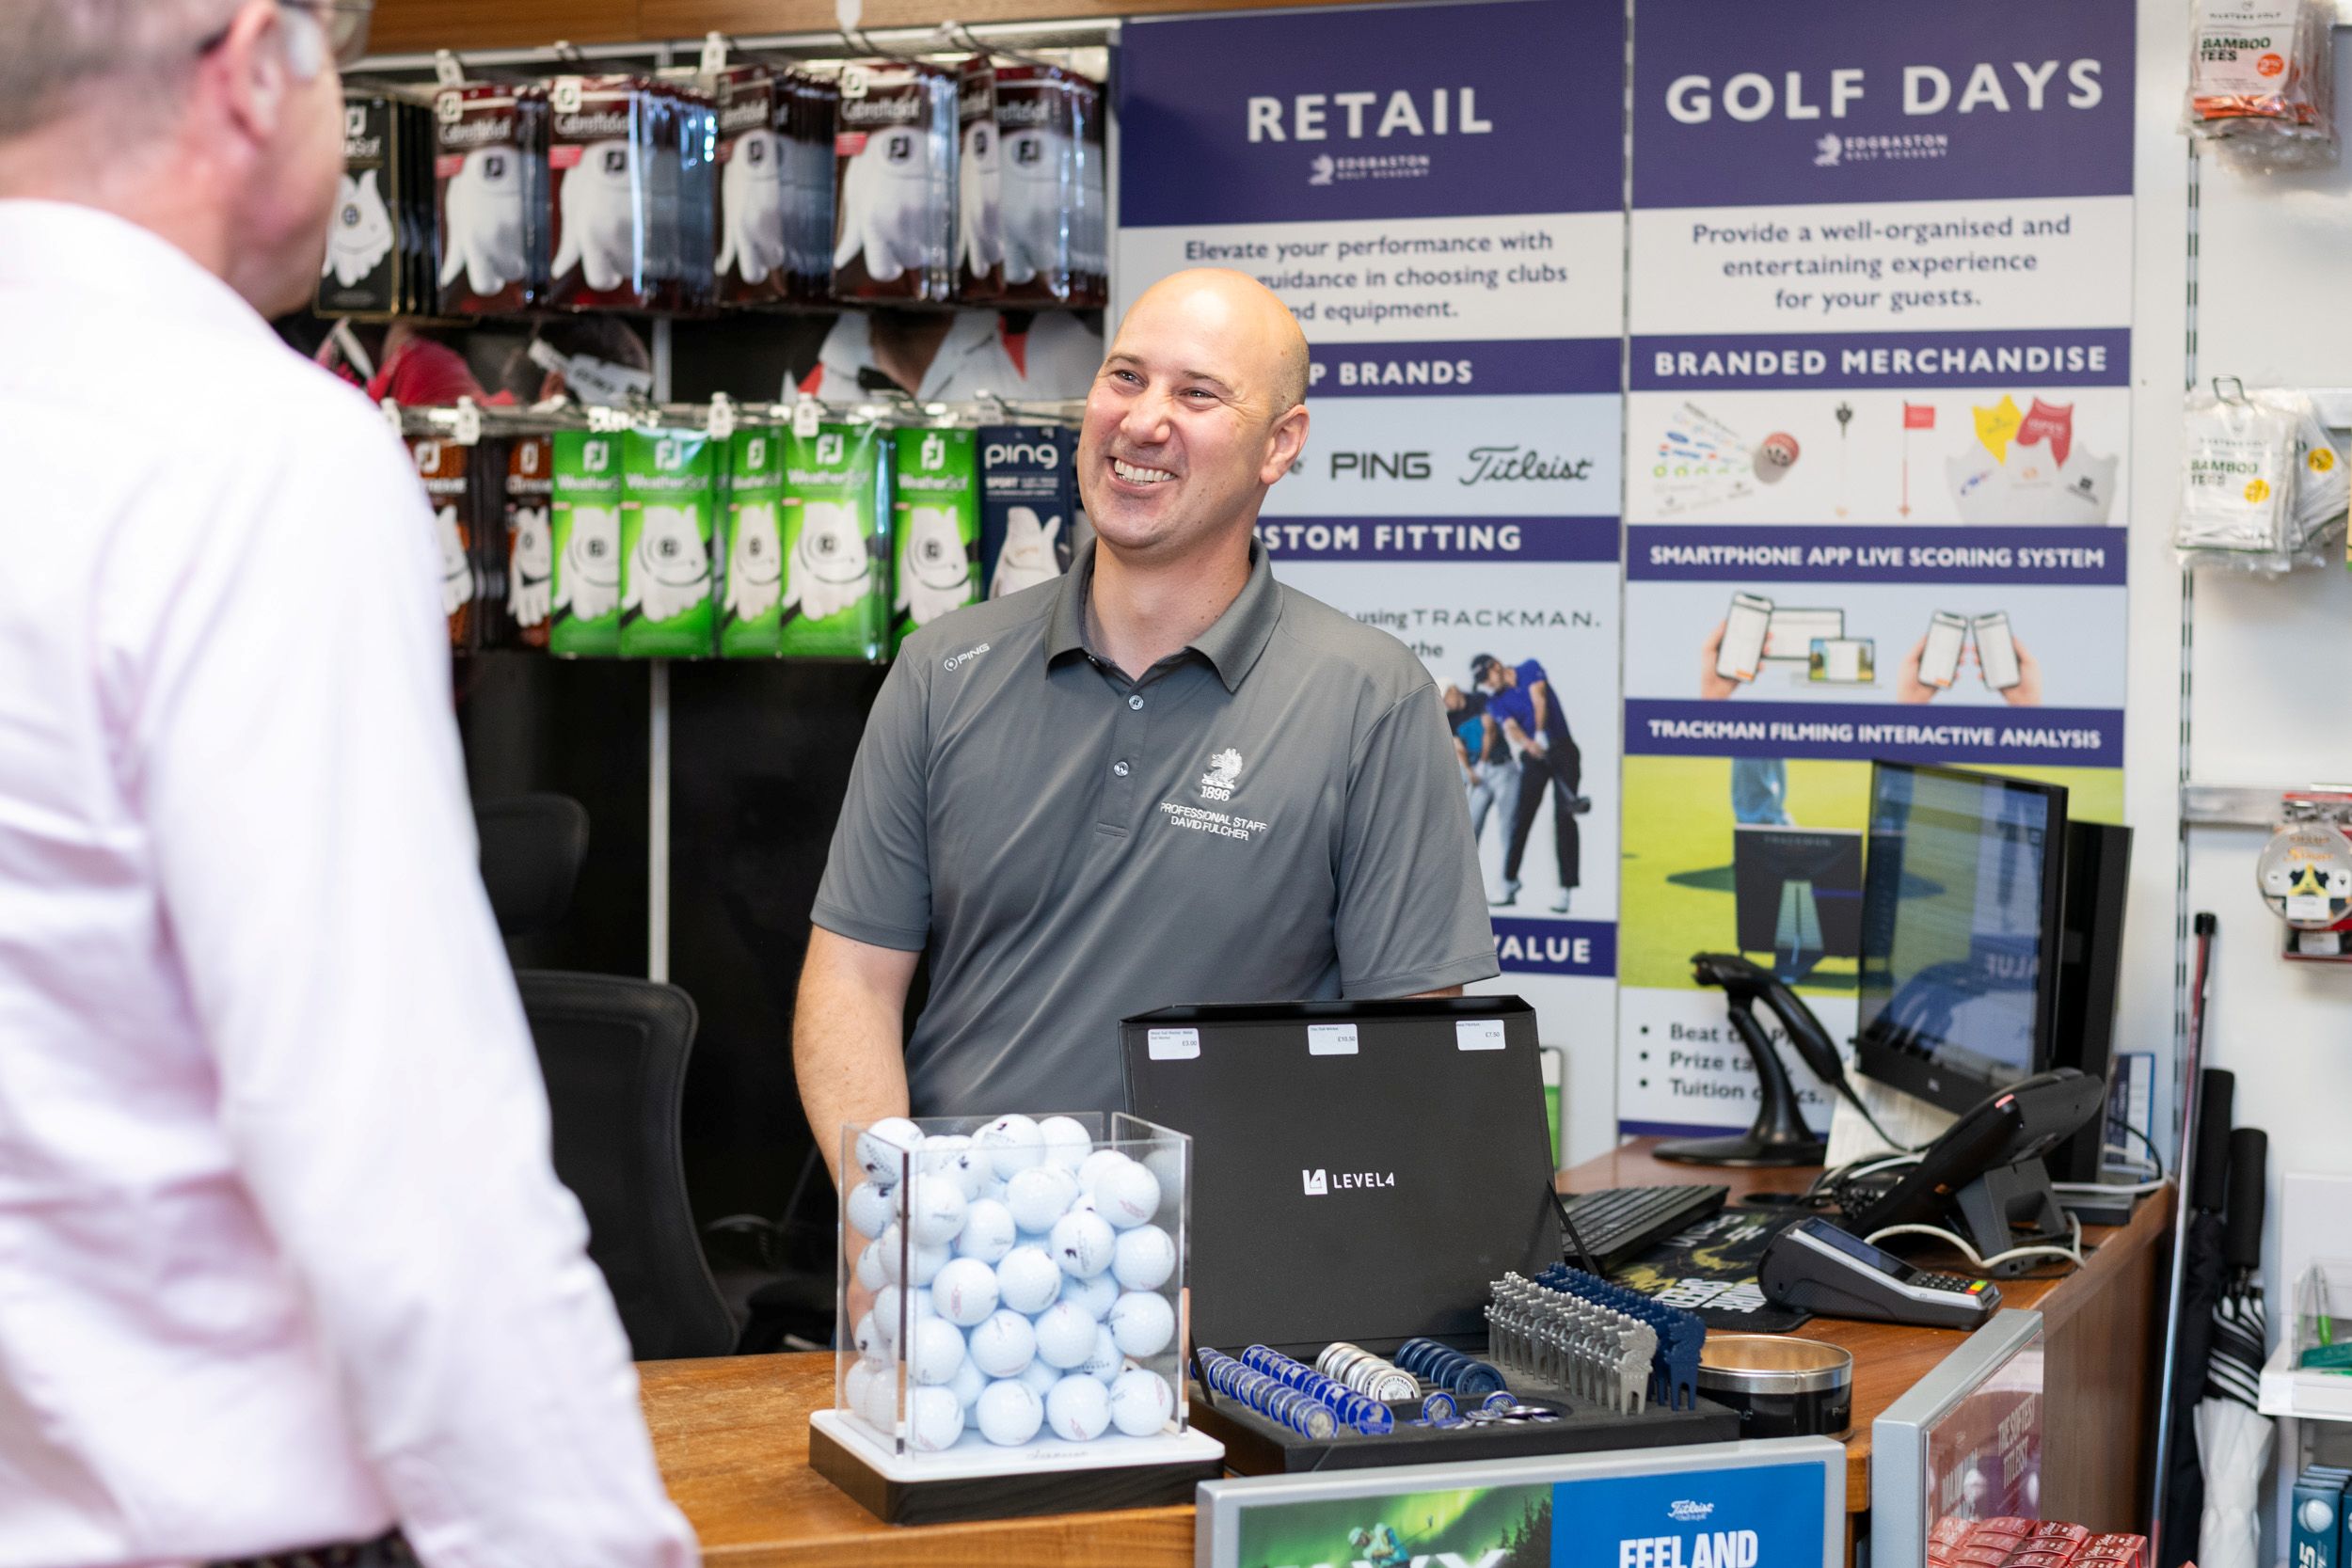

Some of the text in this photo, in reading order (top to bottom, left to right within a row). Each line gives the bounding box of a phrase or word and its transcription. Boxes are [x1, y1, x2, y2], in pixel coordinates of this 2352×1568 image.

[2201, 36, 2271, 50] BAMBOO
[2200, 49, 2237, 63] TEES
[1665, 58, 2104, 123] GOLF DAYS
[1248, 87, 1492, 143] RETAIL
[1693, 214, 2072, 246] Provide a well-organised and
[1185, 232, 1552, 263] Elevate your performance with
[1366, 271, 1386, 286] in
[1394, 266, 1499, 290] choosing
[1507, 263, 1567, 283] clubs
[1723, 249, 2038, 280] entertaining experience
[1289, 301, 1458, 324] nd equipment.
[1775, 289, 1981, 314] for your guests.
[1340, 361, 1473, 386] BRANDS
[1655, 346, 2107, 376] BRANDED MERCHANDISE
[984, 443, 1059, 469] ping
[1330, 451, 1432, 480] PING
[1459, 445, 1593, 486] Titleist
[1254, 525, 1520, 551] STOM FITTING
[1650, 547, 2105, 568] SMARTPHONE APP LIVE SCORING SYSTEM
[1413, 610, 1601, 627] TRACKMAN.
[957, 642, 991, 664] PING
[1648, 721, 2102, 749] TRACKMAN FILMING INTERACTIVE ANALYSIS
[1200, 785, 1231, 801] 1896
[1161, 802, 1268, 832] PROFESSIONAL STAFF
[1170, 816, 1249, 841] DAVID FULCHER
[1671, 1023, 1719, 1042] Beat
[1670, 1052, 1725, 1070] Prize
[1670, 1079, 1745, 1099] Tuition
[1332, 1171, 1395, 1189] LEVEL4
[1667, 1499, 1714, 1517] Titleist
[1691, 1529, 1758, 1568] AND
